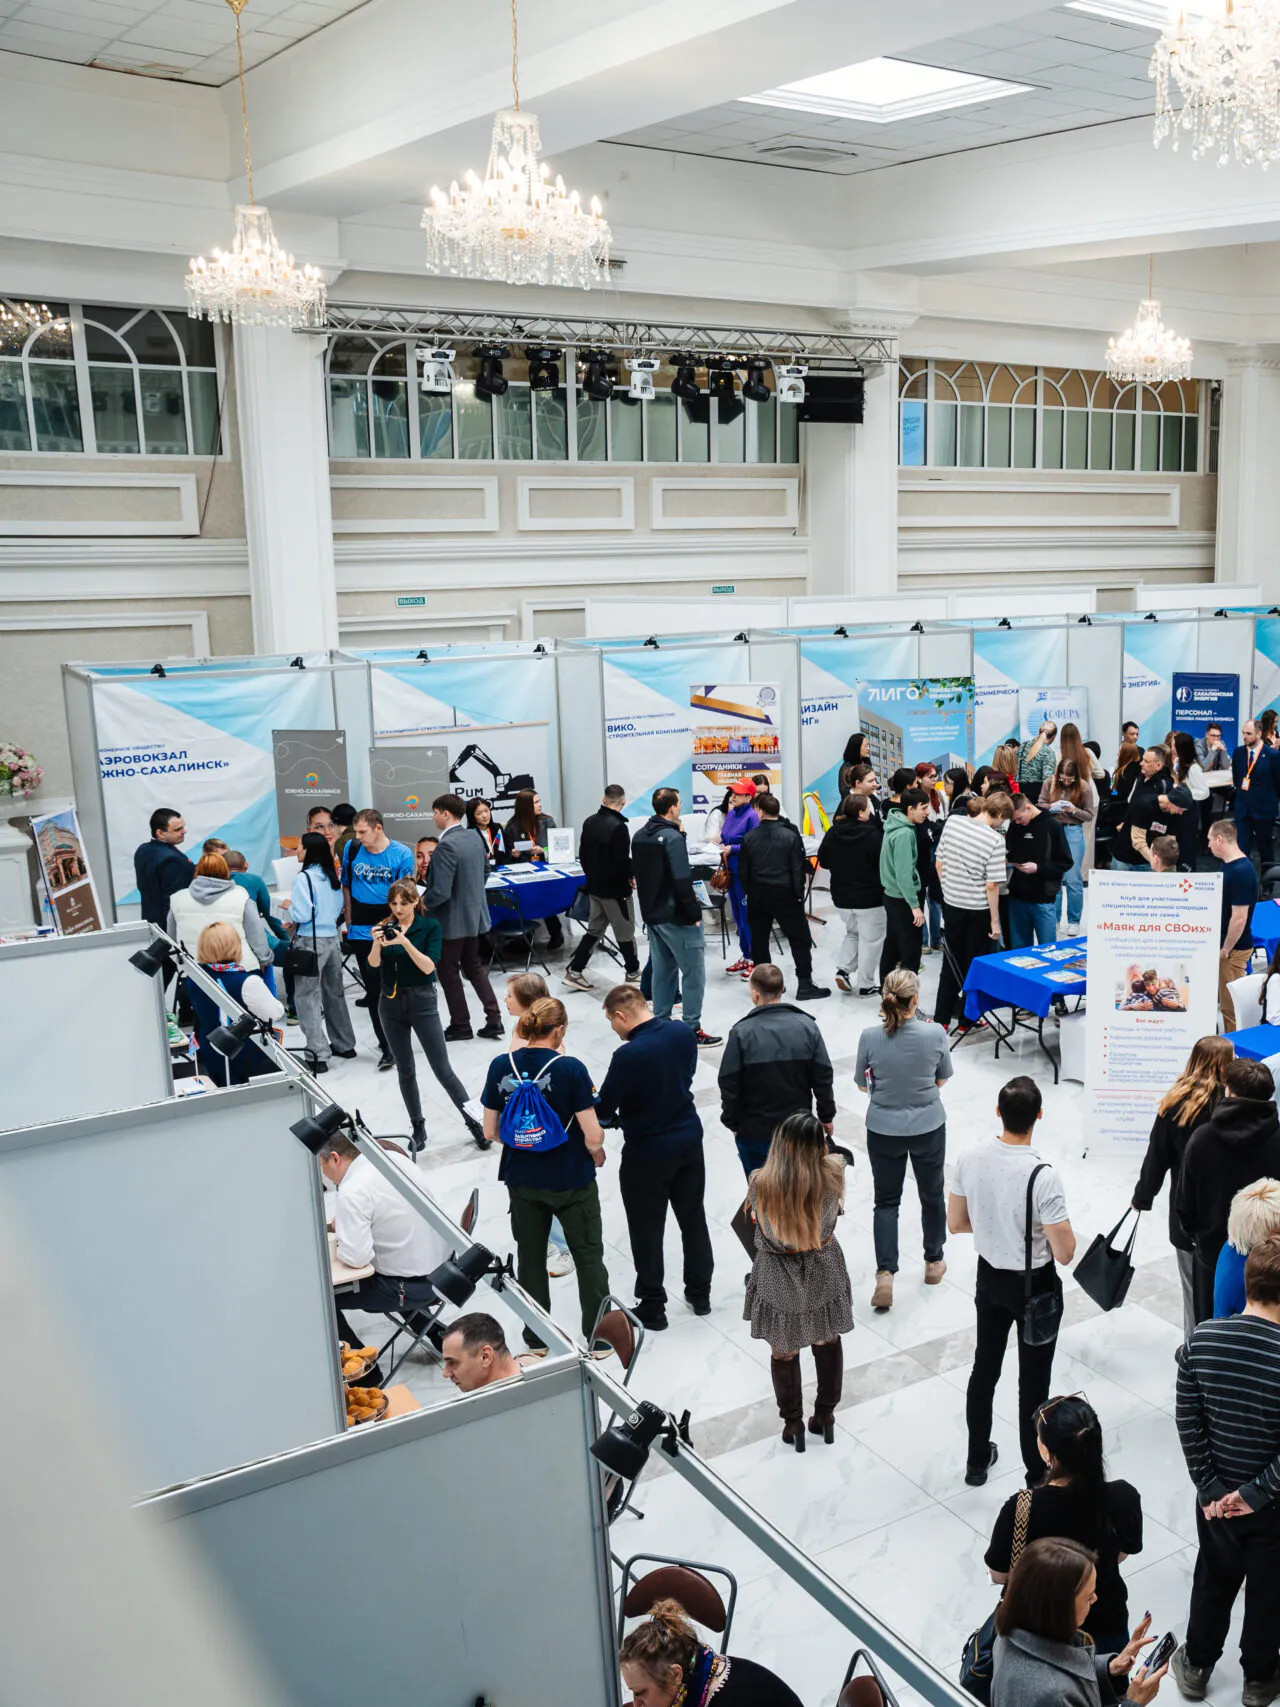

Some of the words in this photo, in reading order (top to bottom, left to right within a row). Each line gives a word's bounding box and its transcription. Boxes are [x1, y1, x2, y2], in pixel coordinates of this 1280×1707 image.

[1128, 680, 1161, 688] ЭНЕРГИЯ»
[607, 723, 636, 733] ВИКО,
[101, 760, 230, 779] ЖНО-САХАЛИНСК»
[1096, 922, 1135, 931] «Маяк
[1138, 924, 1161, 933] для
[1164, 923, 1212, 933] СВОих»
